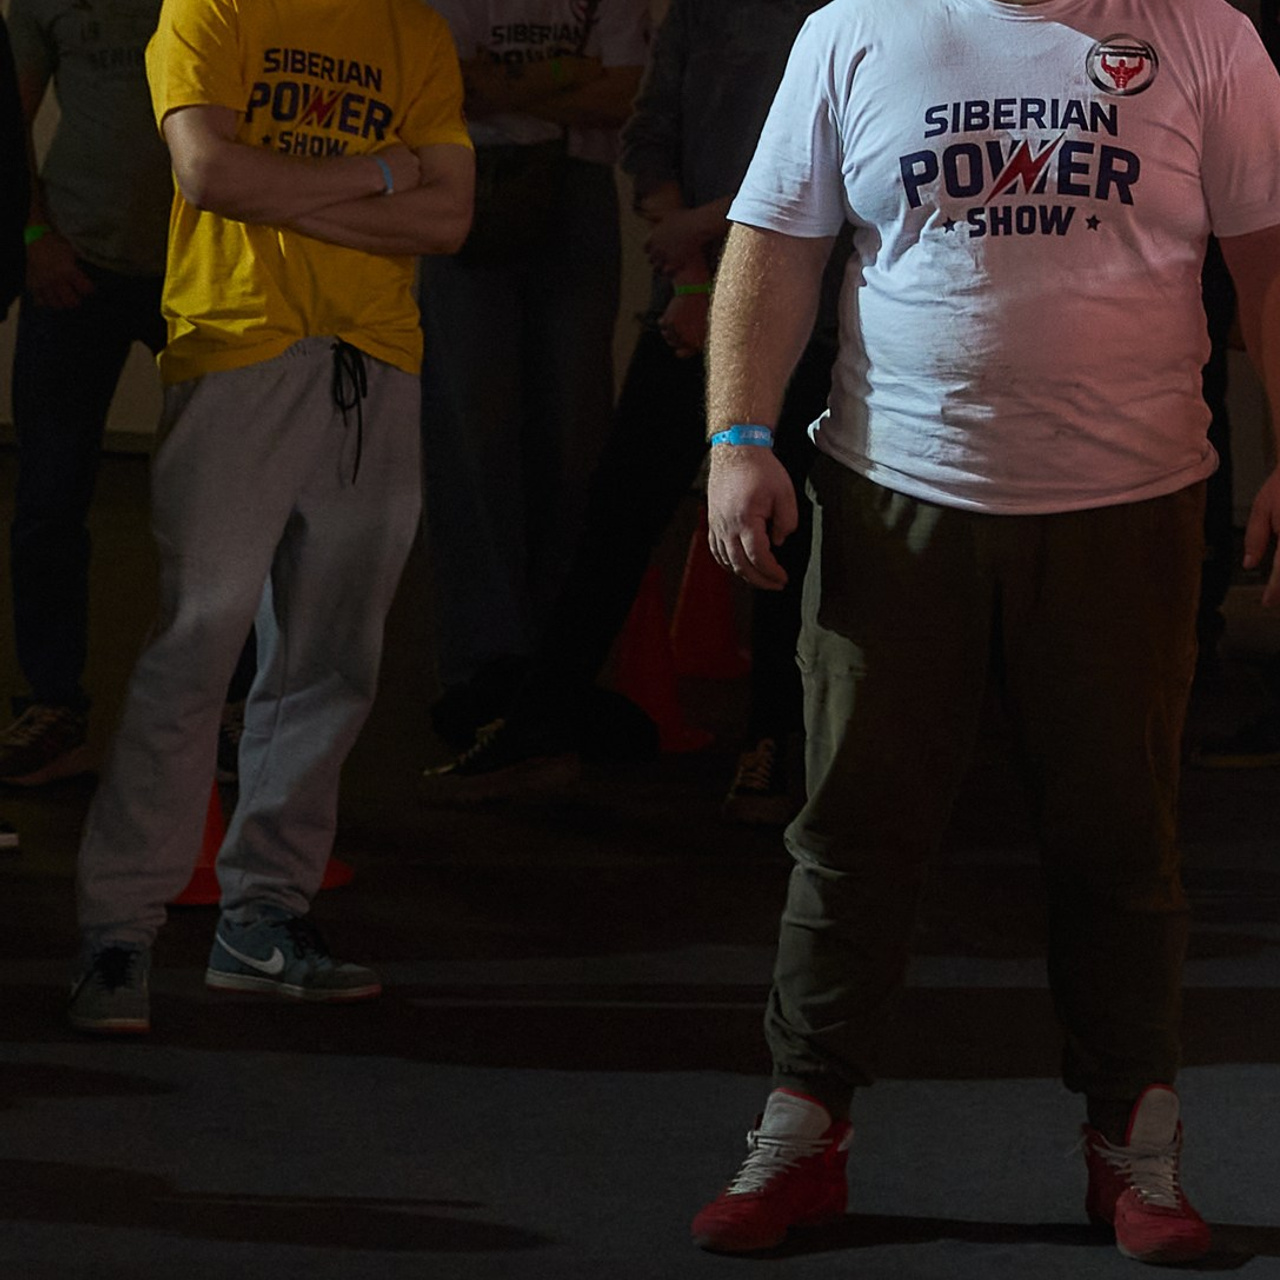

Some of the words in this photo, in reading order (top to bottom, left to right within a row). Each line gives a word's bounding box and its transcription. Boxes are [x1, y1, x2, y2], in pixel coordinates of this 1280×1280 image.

[492, 23, 585, 45] SIBERIAN
[264, 48, 382, 92] SIBERIAN
[245, 81, 393, 142] POWER
[924, 98, 1118, 138] SIBERIAN
[278, 131, 348, 157] SHOW
[899, 135, 1141, 209] POWER
[967, 205, 1075, 238] SHOW
